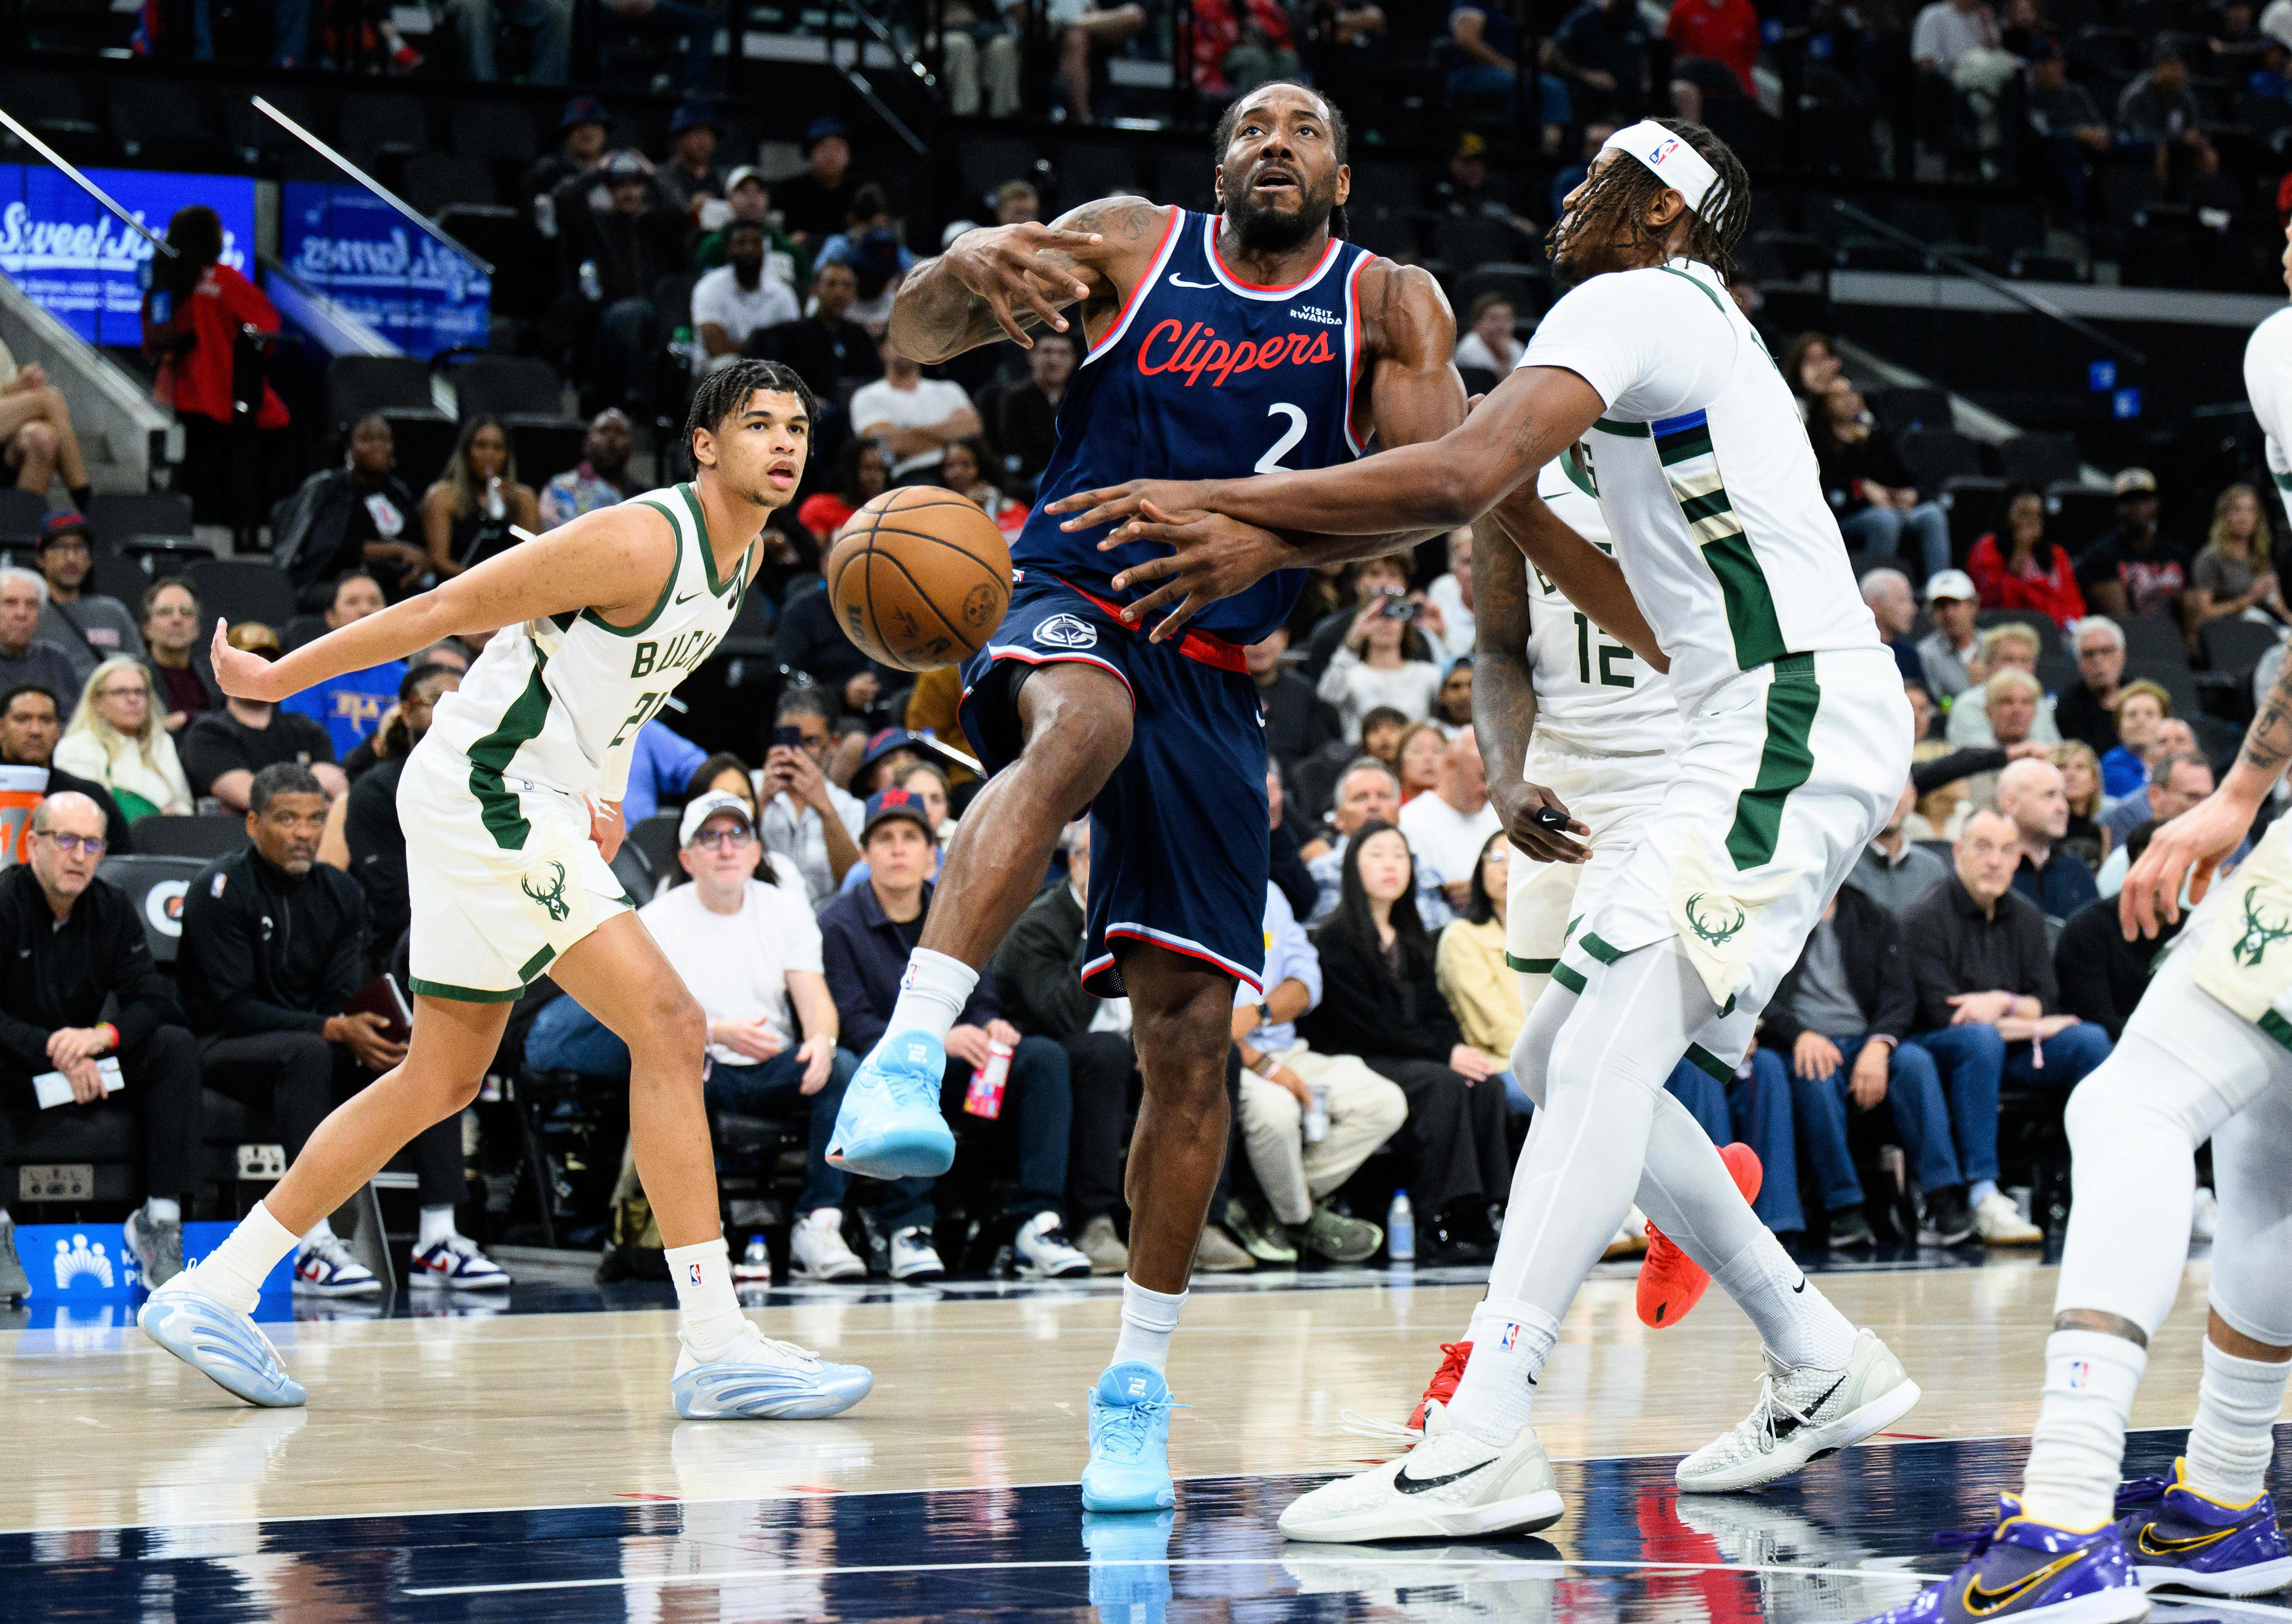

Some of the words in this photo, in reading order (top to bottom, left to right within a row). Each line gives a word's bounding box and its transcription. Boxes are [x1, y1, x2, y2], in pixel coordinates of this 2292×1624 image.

[1290, 309, 1343, 325] RWANDA
[1302, 305, 1333, 318] VISIT
[1137, 319, 1336, 387] Clippers
[1254, 403, 1308, 474] 2
[630, 630, 719, 679] BUCK
[1573, 611, 1635, 689] 12
